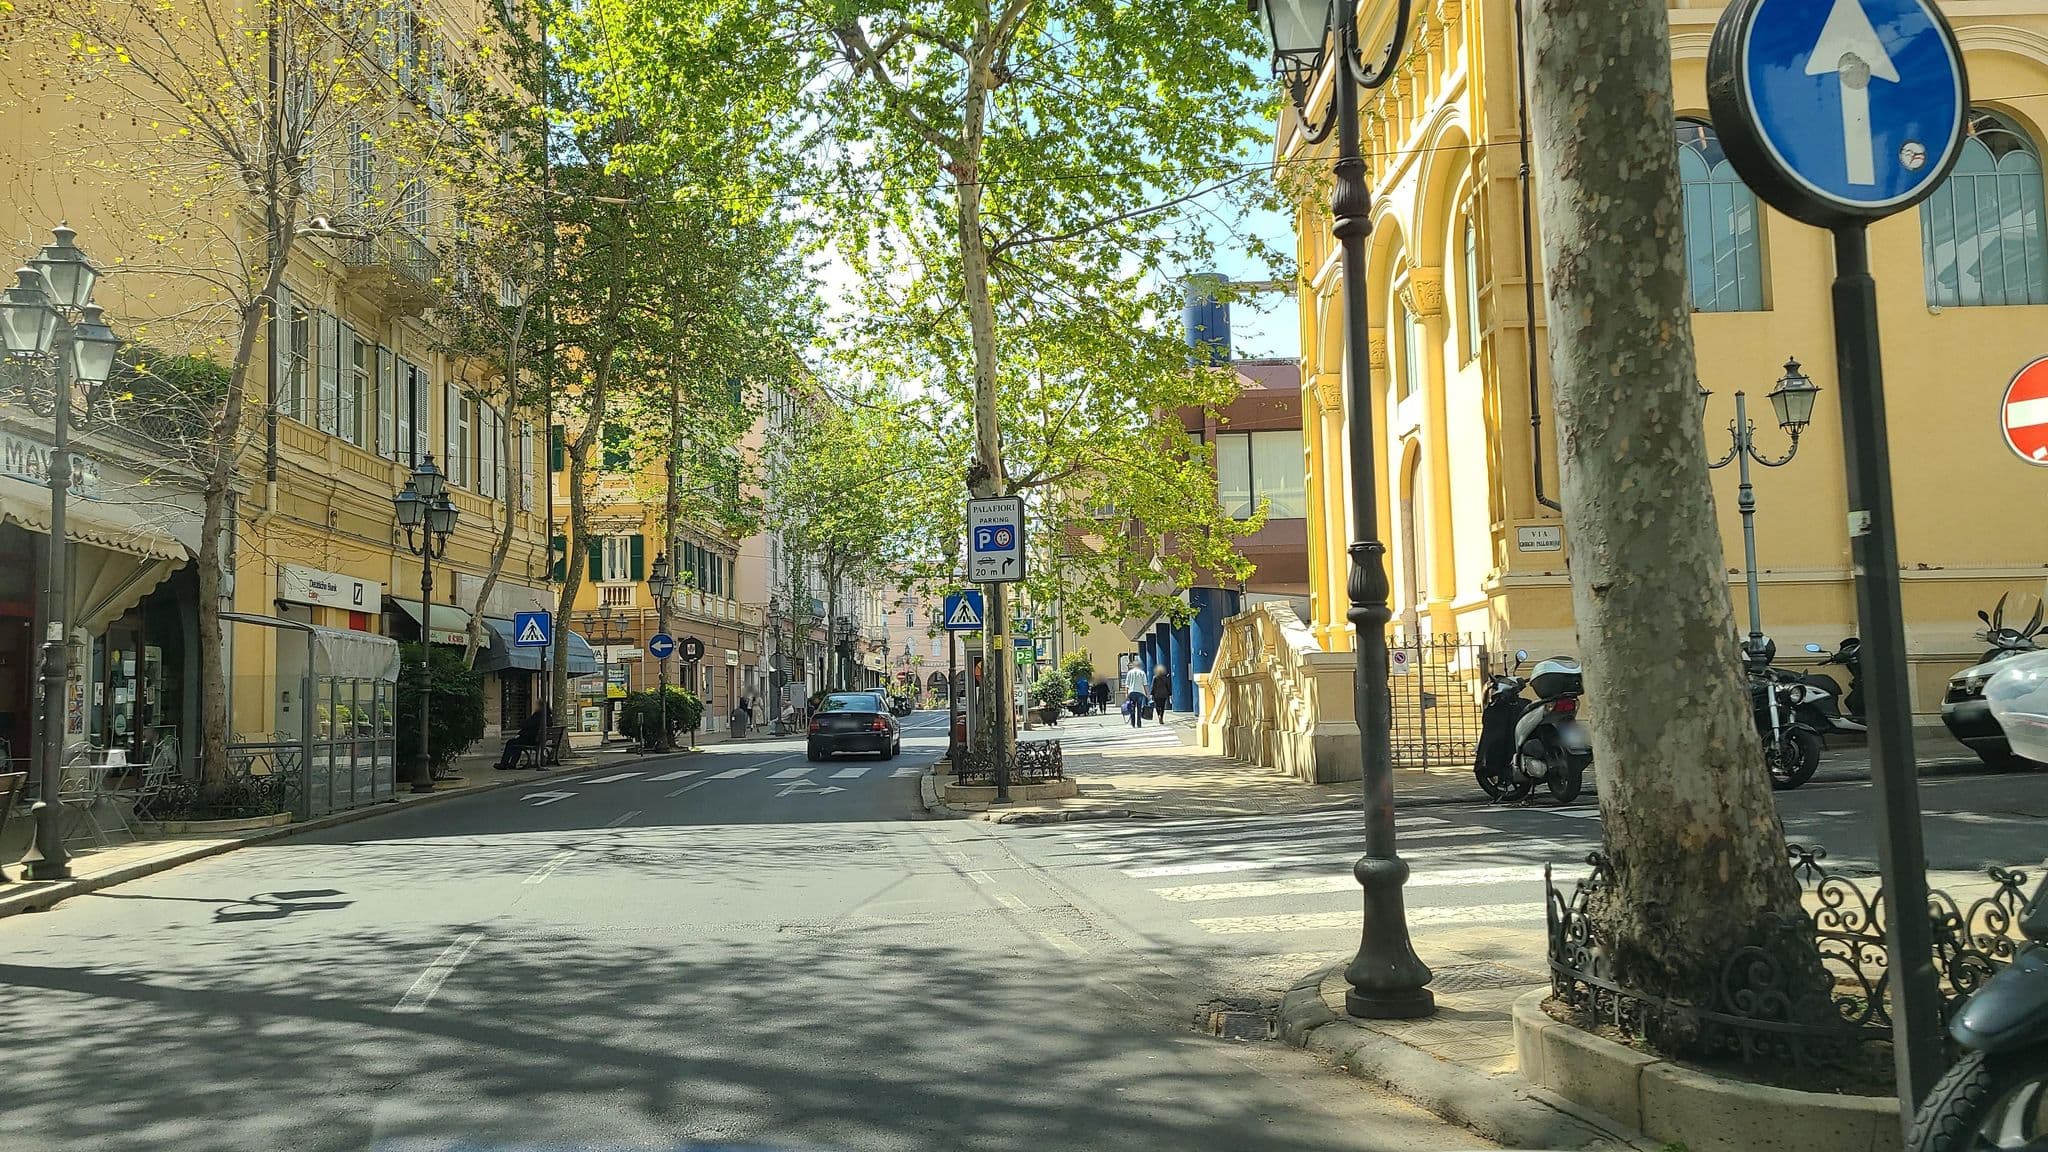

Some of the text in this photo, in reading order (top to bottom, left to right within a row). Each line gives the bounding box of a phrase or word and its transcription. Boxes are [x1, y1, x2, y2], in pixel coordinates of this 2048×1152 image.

[973, 503, 1016, 514] PALAFIORI
[979, 516, 1009, 524] PARKING
[979, 532, 991, 549] P
[975, 568, 986, 577] 20
[327, 582, 337, 593] Bank
